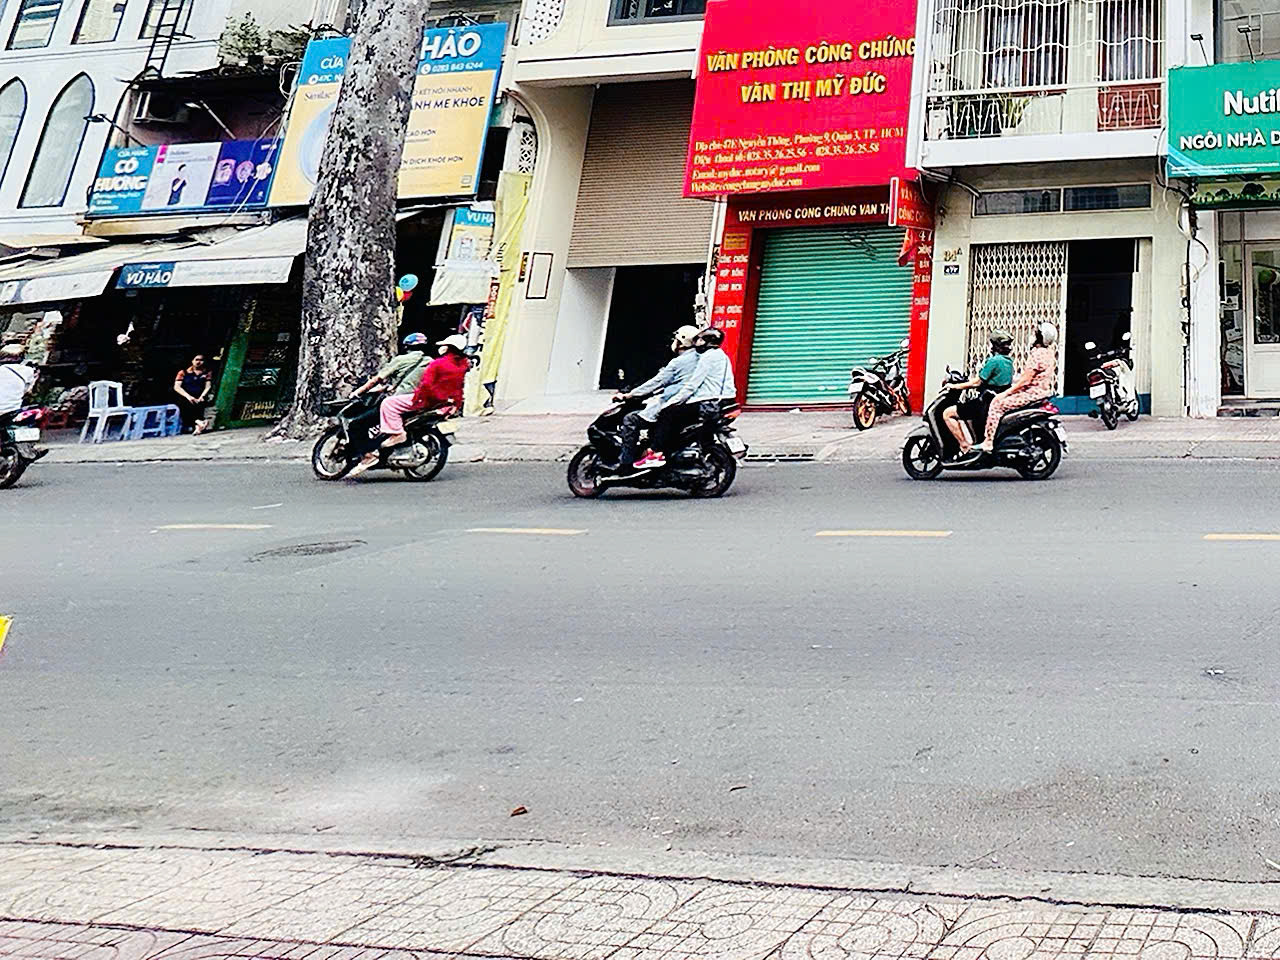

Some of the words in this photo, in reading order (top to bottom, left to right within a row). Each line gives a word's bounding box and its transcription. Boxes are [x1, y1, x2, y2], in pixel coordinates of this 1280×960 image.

[707, 51, 739, 72] VĂN
[742, 45, 800, 69] PHÒNG
[805, 41, 852, 64] CÔNG
[858, 35, 915, 60] CHỨNG
[741, 83, 776, 103] VĂN
[782, 81, 811, 101] THỊ
[816, 73, 843, 97] MỸ
[850, 72, 886, 95] ĐỨC
[1180, 131, 1222, 150] NGÔI
[1227, 127, 1266, 147] NHÀ
